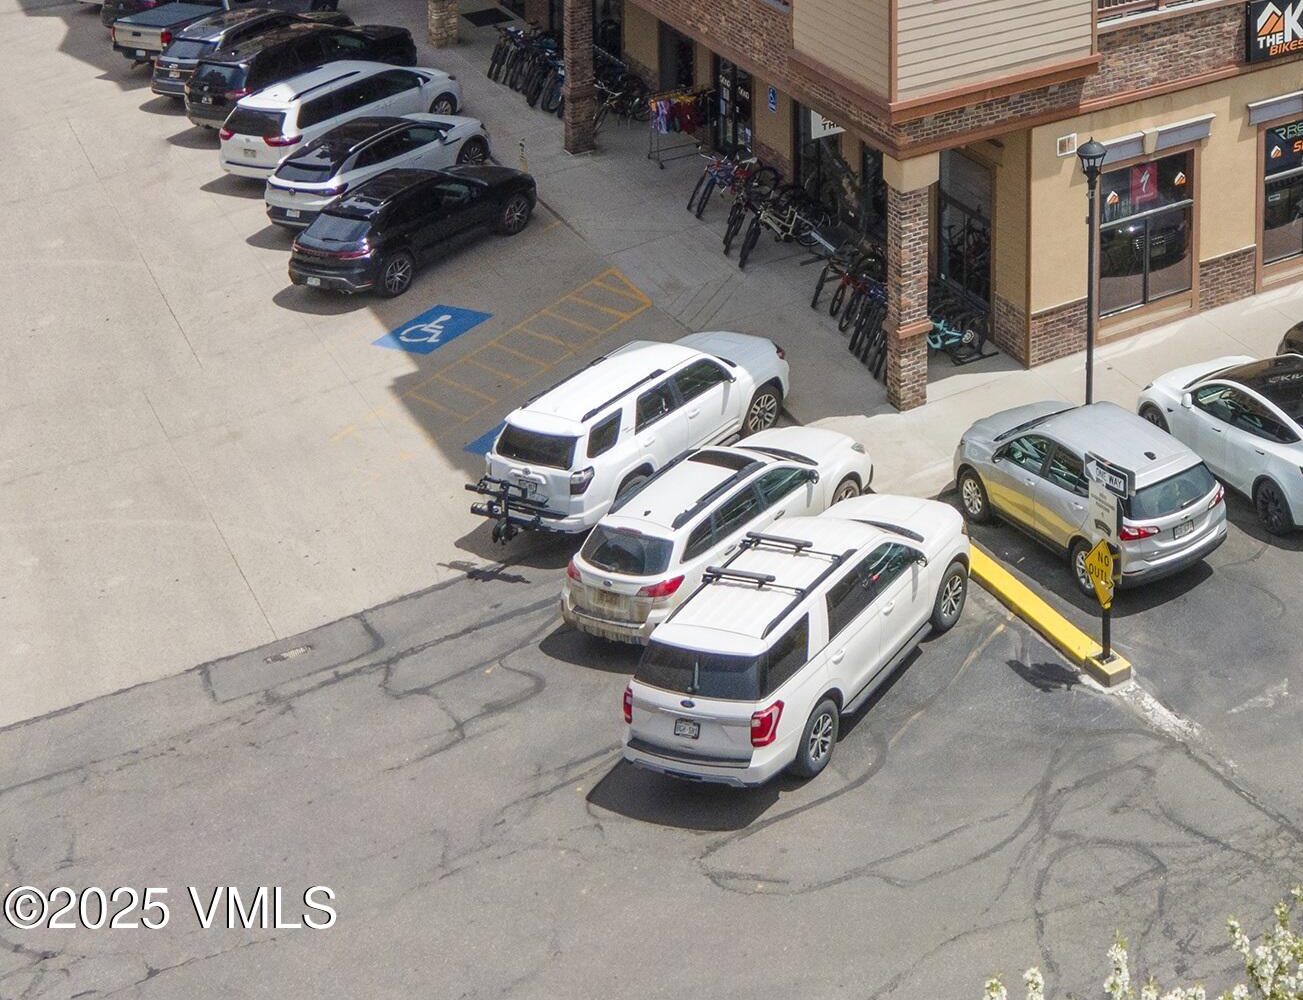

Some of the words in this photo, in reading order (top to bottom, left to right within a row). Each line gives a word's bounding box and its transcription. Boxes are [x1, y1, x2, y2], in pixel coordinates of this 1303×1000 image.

[1257, 32, 1284, 49] THE
[1108, 476, 1122, 489] WAY
[1097, 551, 1110, 567] NO
